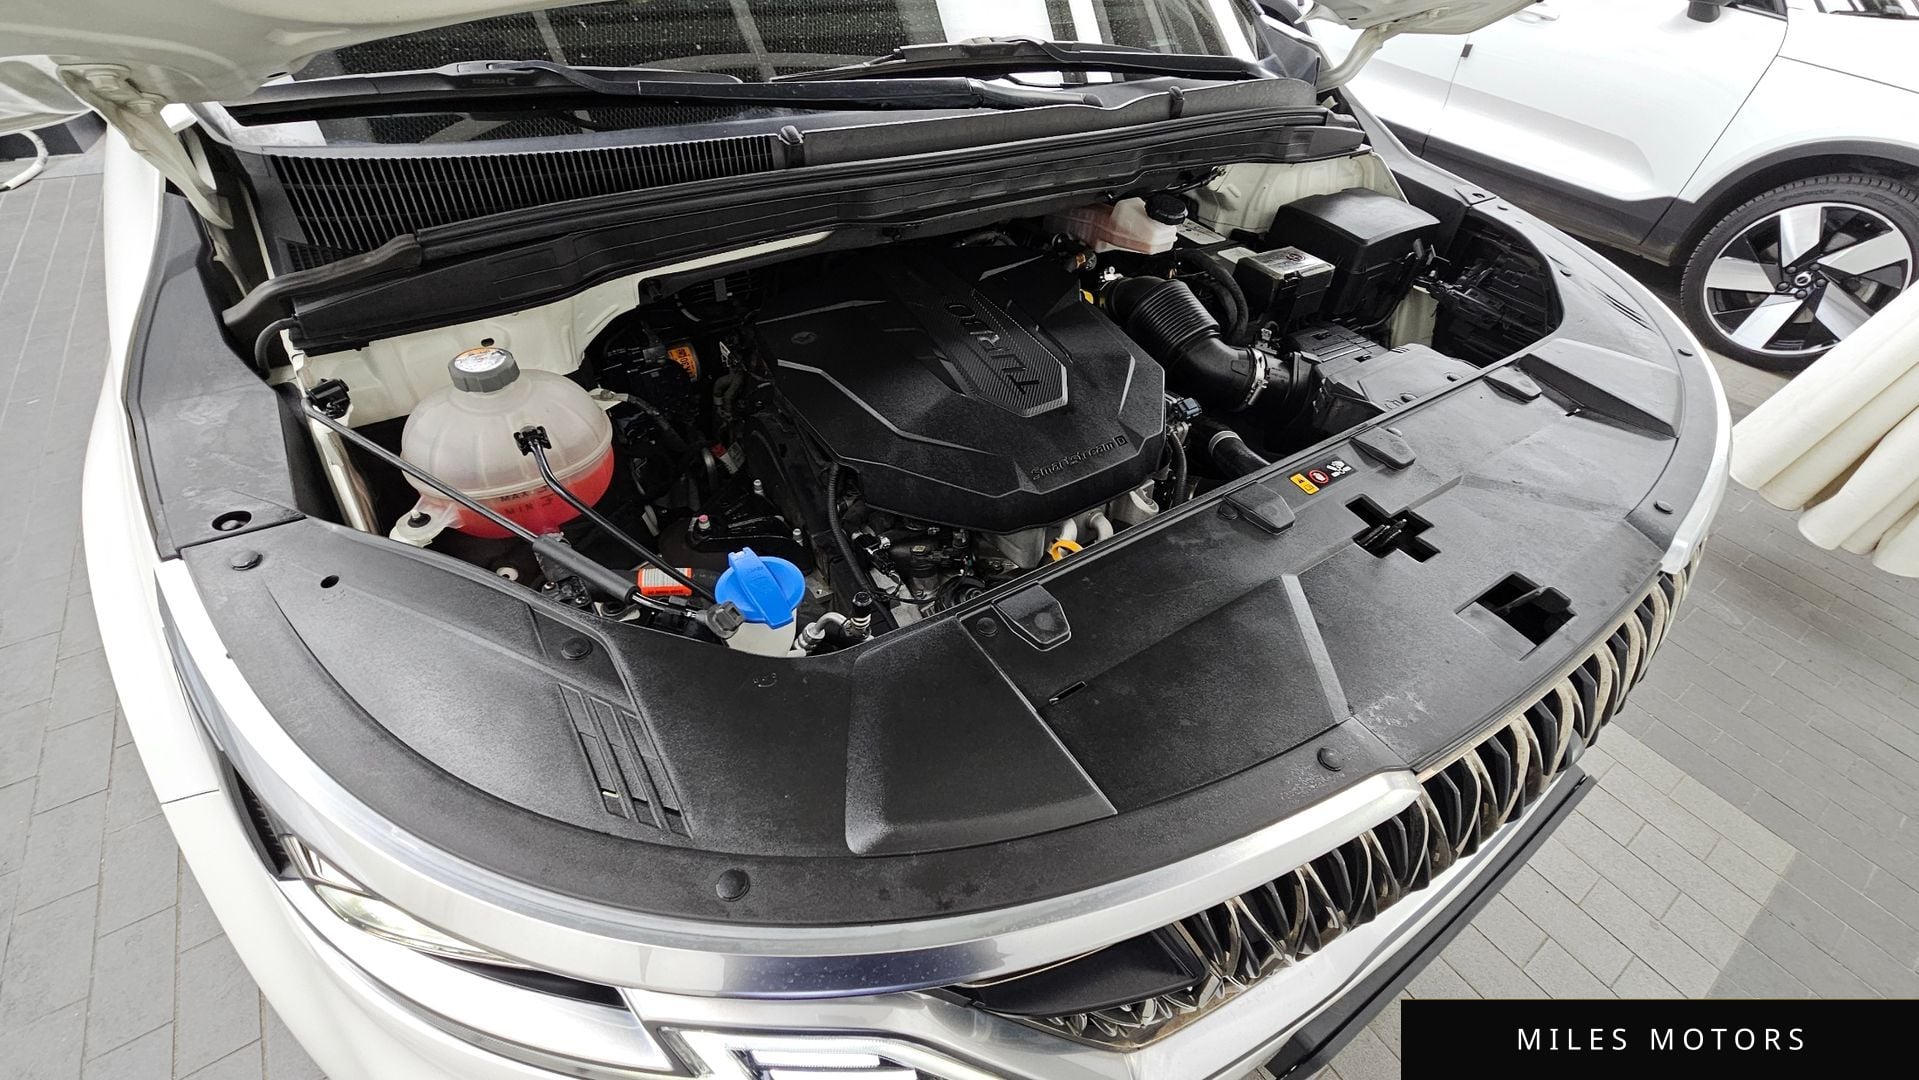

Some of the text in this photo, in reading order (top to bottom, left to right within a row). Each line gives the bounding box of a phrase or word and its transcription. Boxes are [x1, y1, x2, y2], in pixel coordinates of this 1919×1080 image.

[945, 304, 1040, 395] TURBO
[1031, 435, 1128, 480] Smartstream D
[500, 490, 528, 502] MAX
[504, 503, 534, 515] MIN
